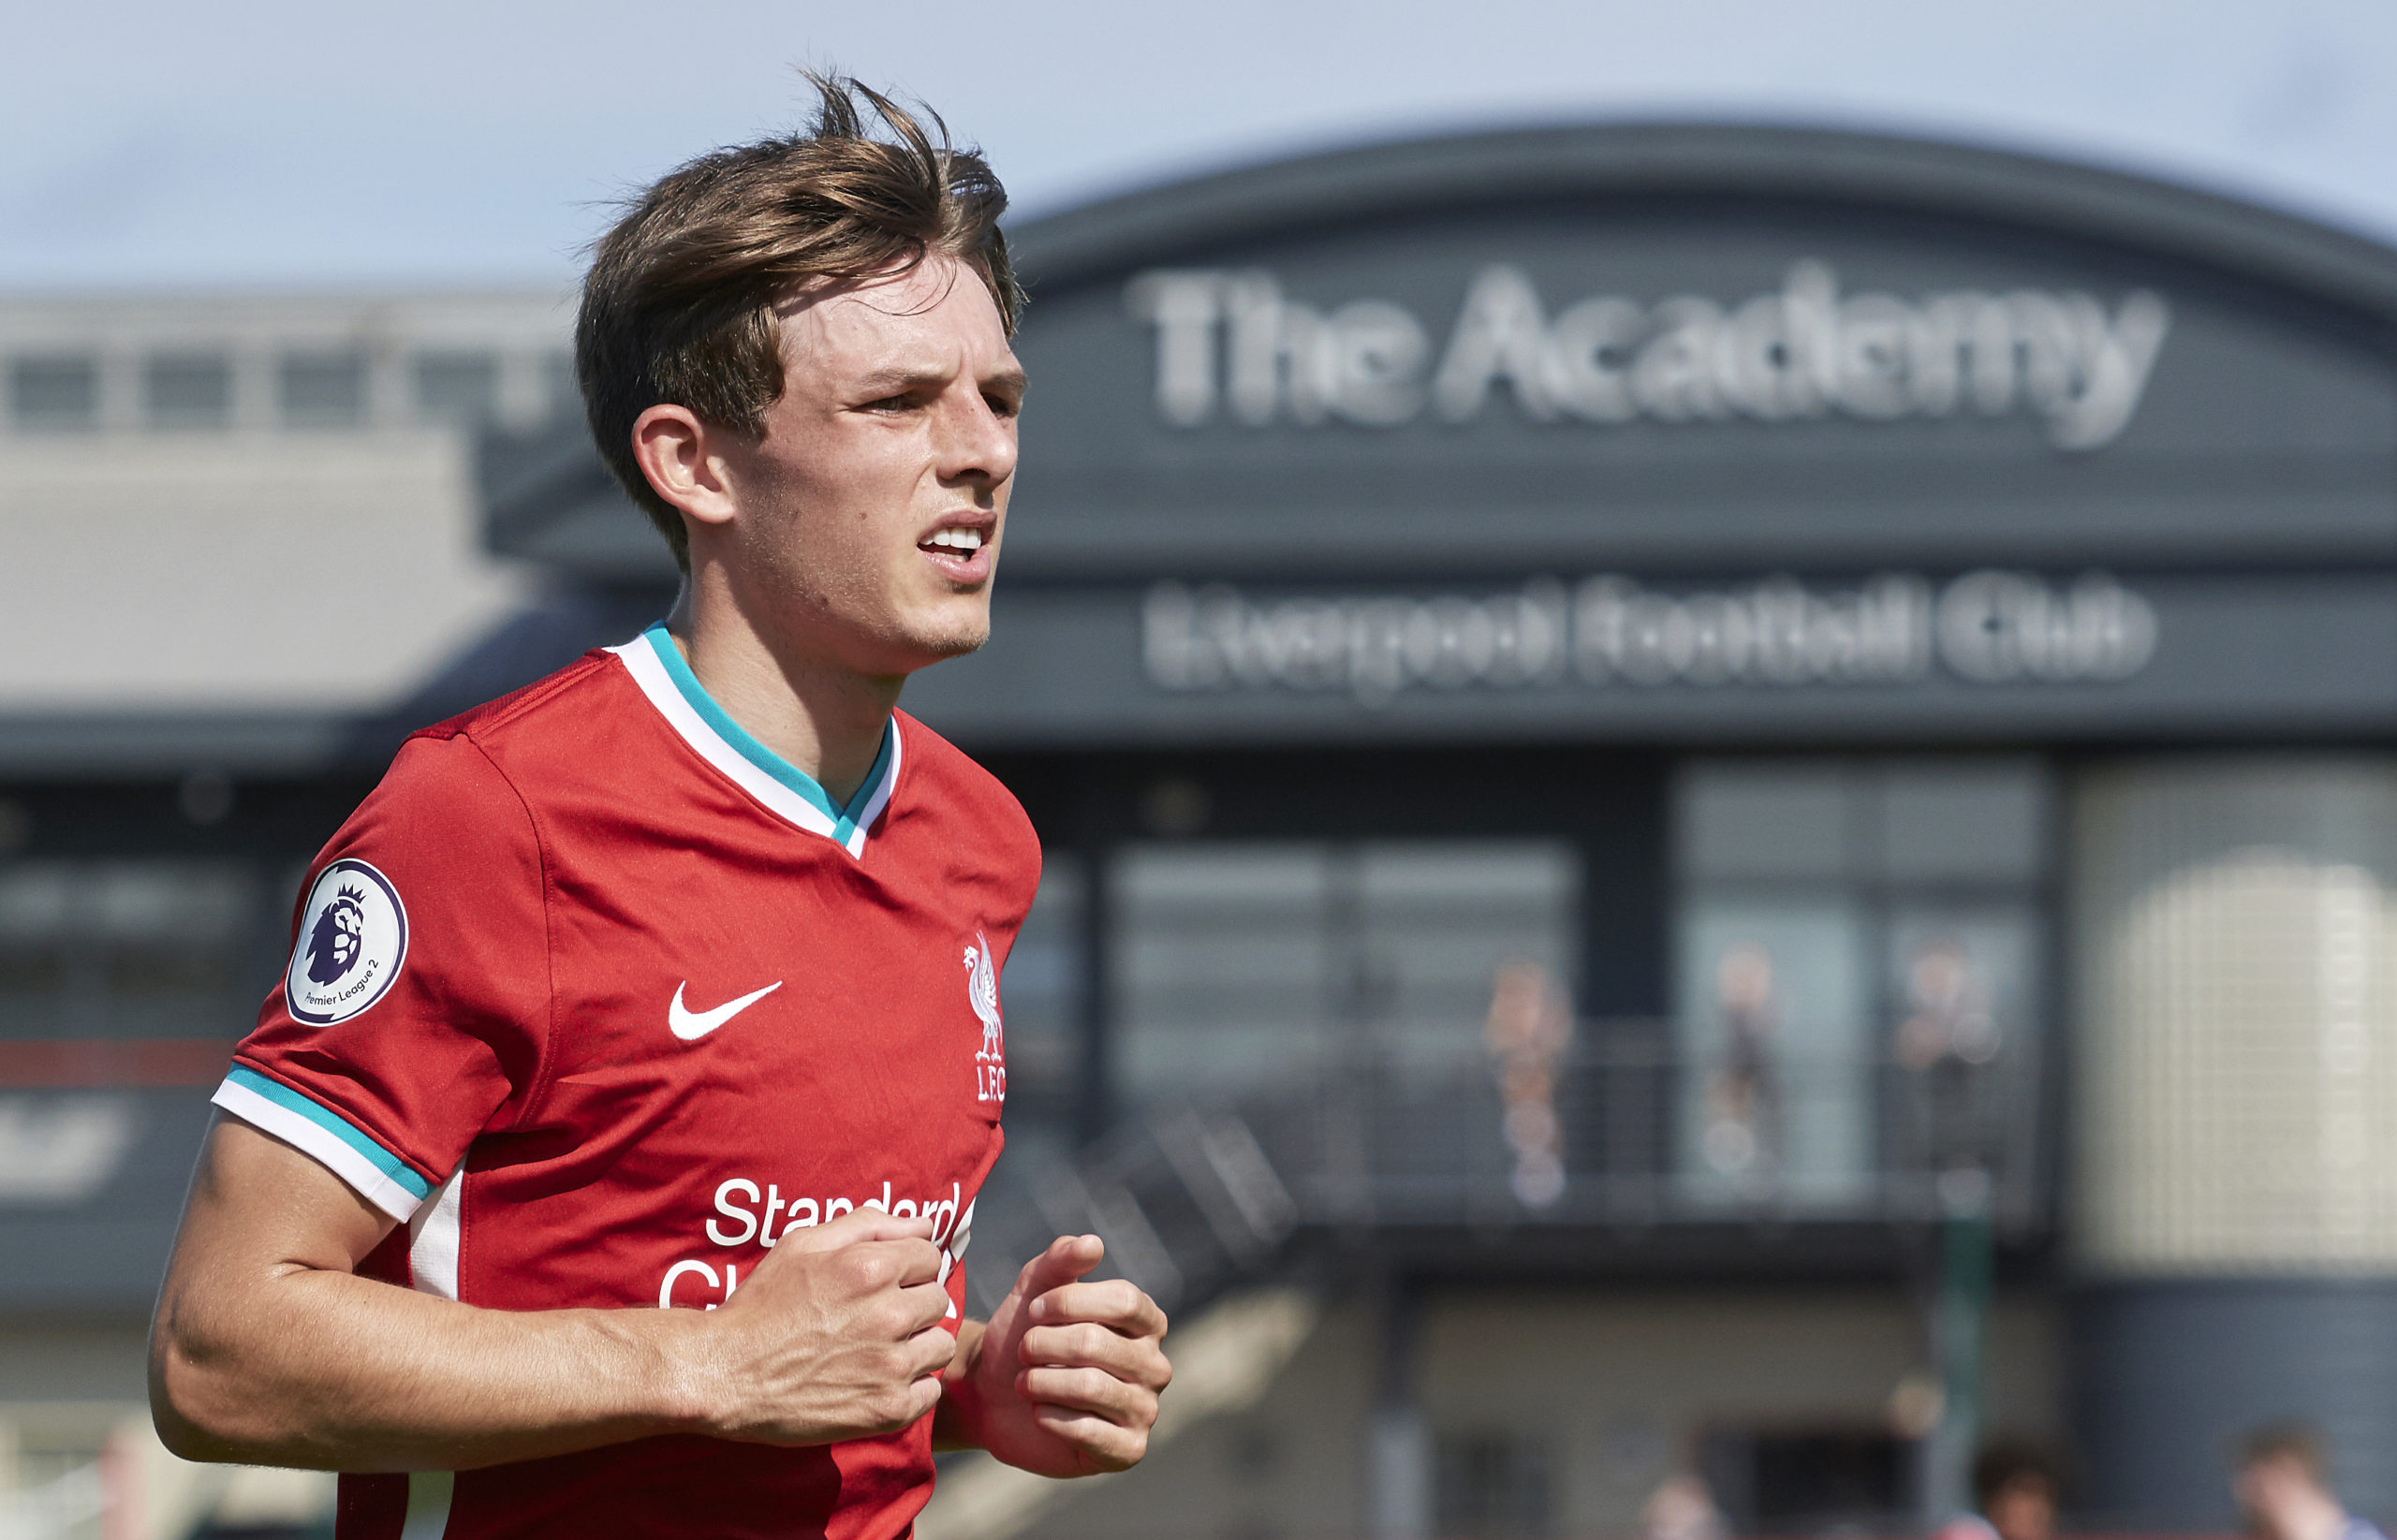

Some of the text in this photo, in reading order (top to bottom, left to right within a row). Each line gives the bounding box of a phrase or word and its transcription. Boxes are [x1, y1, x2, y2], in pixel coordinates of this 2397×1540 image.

[1131, 259, 2170, 448] The Academy
[1144, 569, 2157, 708] Liverpool Football Club
[304, 959, 379, 1005] Premier League 2
